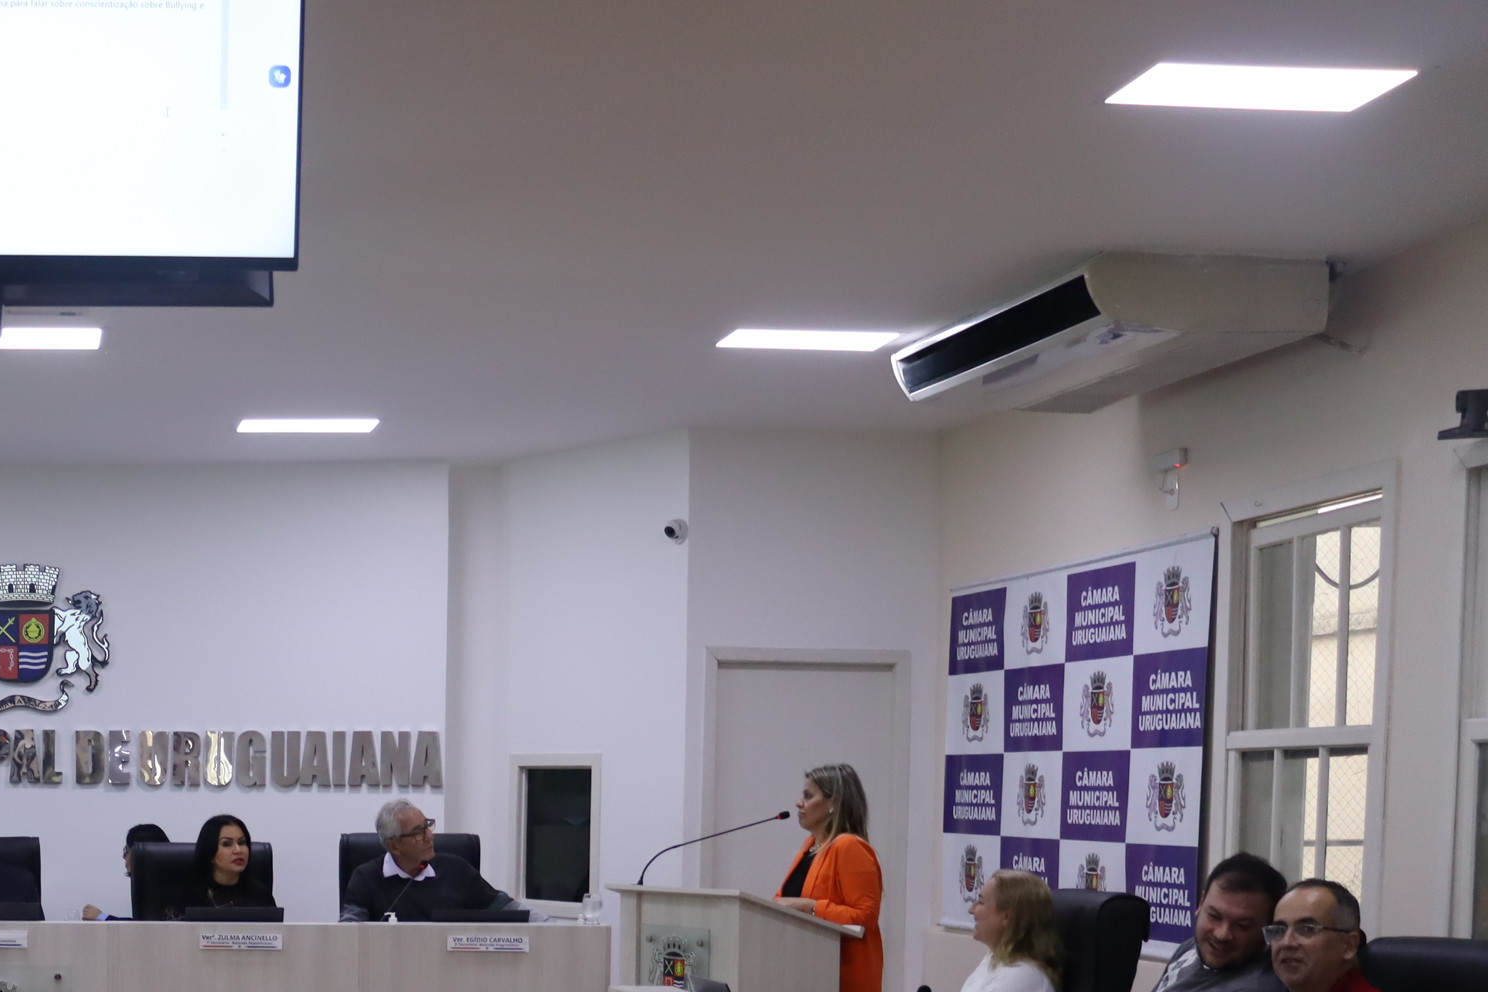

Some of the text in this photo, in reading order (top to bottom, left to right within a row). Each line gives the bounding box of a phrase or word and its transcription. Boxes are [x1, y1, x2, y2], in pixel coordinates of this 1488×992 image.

[1081, 585, 1120, 607] CÂMARA
[962, 608, 993, 626] CÂMARA
[1074, 605, 1125, 627] MUNICIPAL
[958, 625, 997, 644] MUNICIPAL
[1072, 623, 1126, 646] URUGUAIANA
[956, 642, 998, 660] URUGUAIANA
[1149, 669, 1192, 690] CÂMARA
[1018, 683, 1050, 701] CÂMARA
[1012, 702, 1055, 720] MUNICIPAL
[1141, 692, 1200, 712] MUNICIPAL
[1010, 720, 1057, 737] URUGUAIANA
[1139, 712, 1201, 731] URUGUAIANA
[75, 729, 131, 785] DE
[139, 730, 443, 788] URUGUAIANA
[959, 769, 991, 786] CÂMARA
[1075, 767, 1114, 786] CÂMARA
[955, 789, 995, 804] MUNICIPAL
[1069, 791, 1119, 807] MUNICIPAL
[953, 805, 996, 820] URUGUAIANA
[1067, 809, 1120, 826] URUGUAIANA
[1012, 853, 1045, 872] CÂMARA
[1142, 862, 1185, 884] CÂMARA
